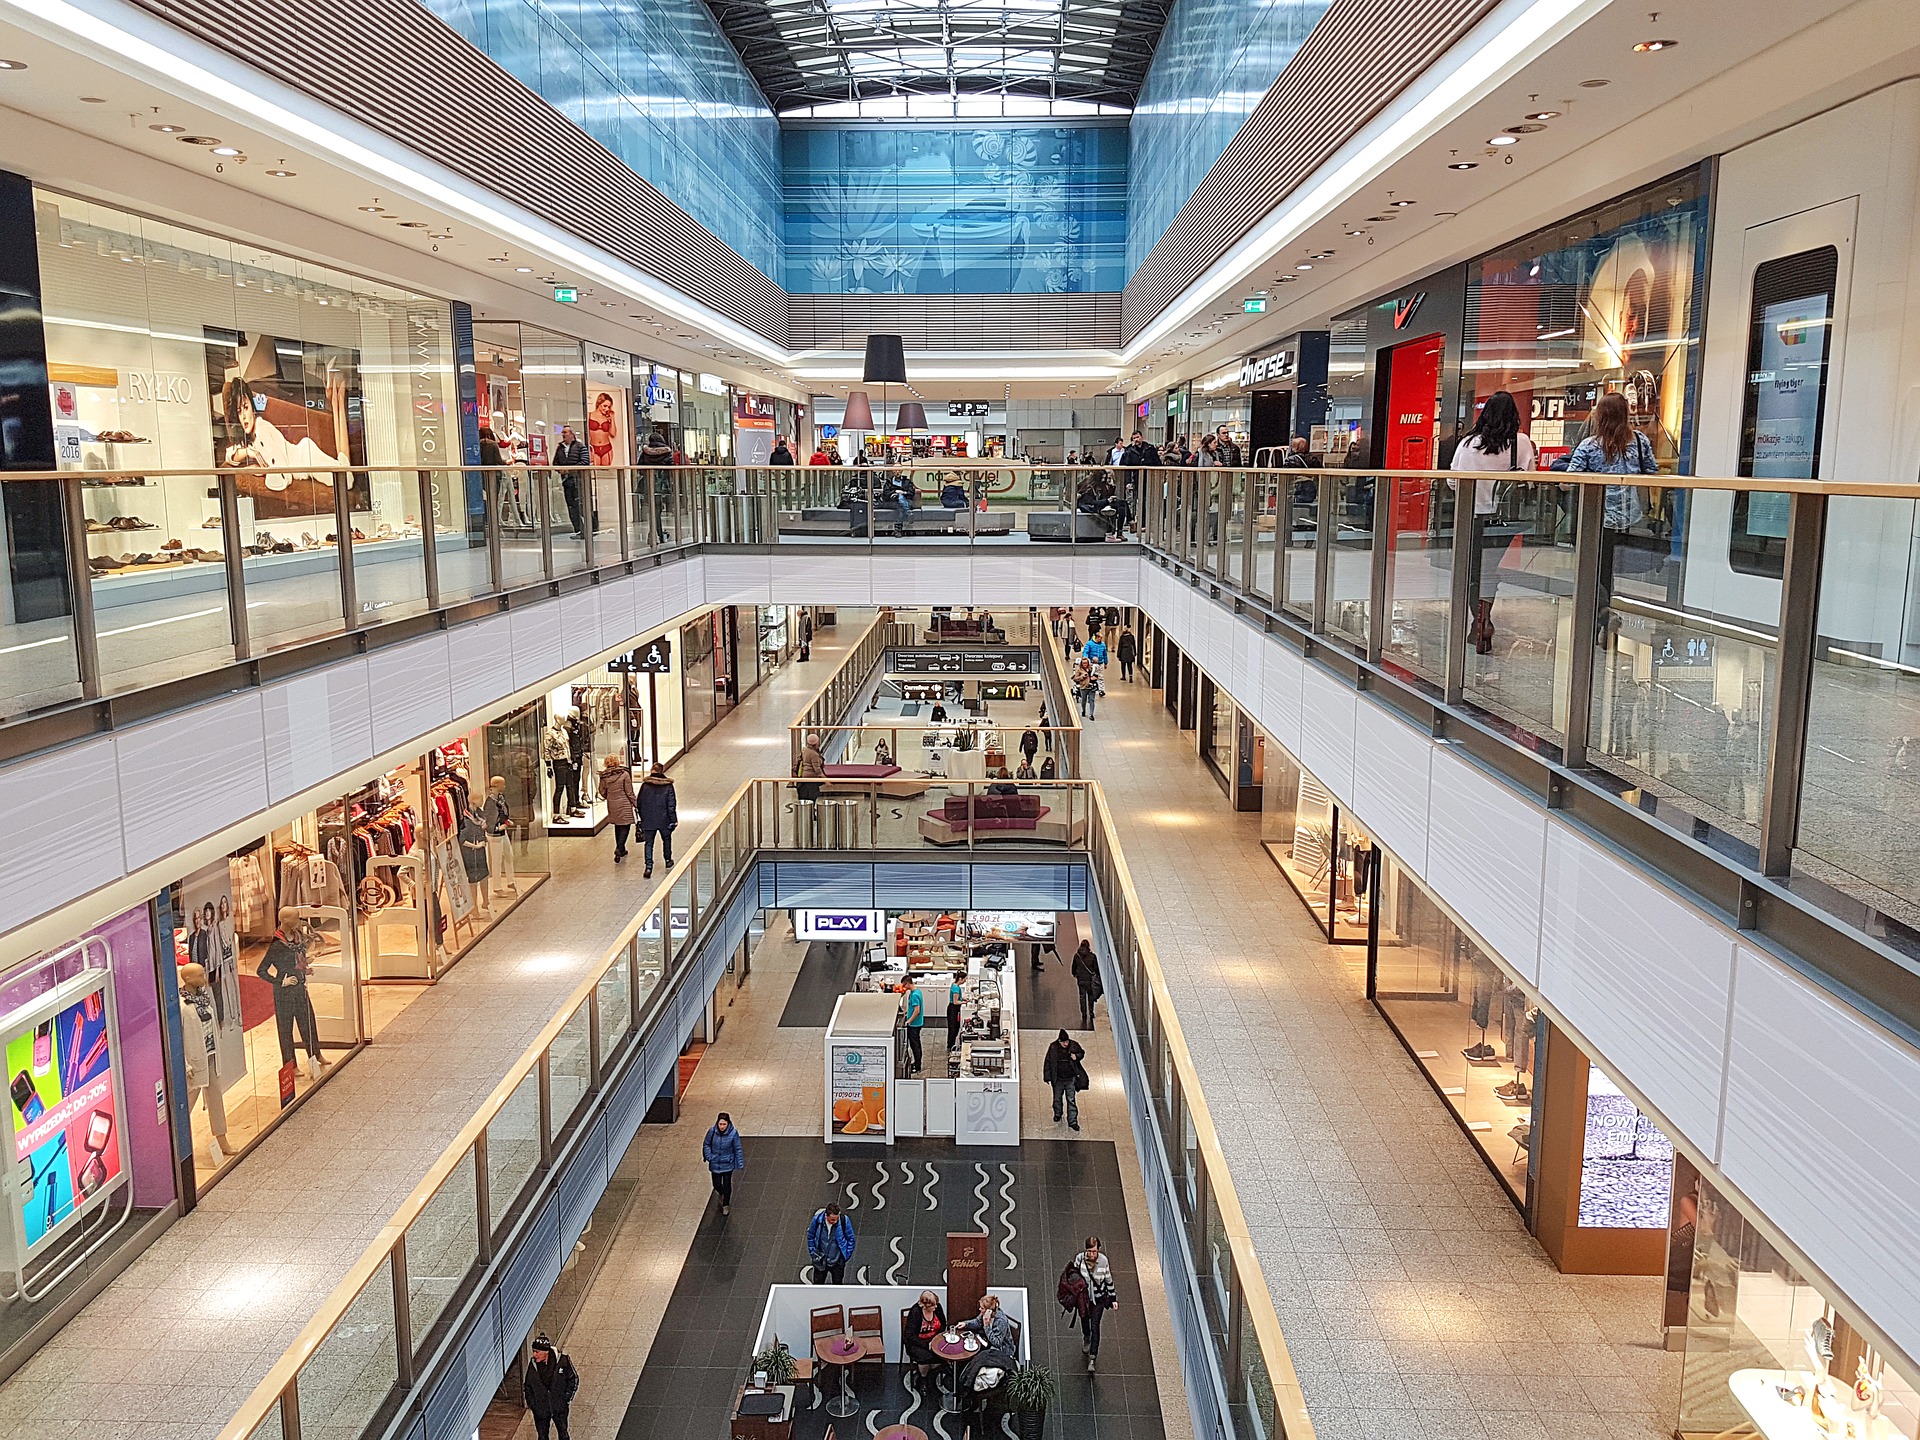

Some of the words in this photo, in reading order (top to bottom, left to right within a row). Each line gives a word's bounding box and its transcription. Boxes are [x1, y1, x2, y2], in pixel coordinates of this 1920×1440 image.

[1240, 350, 1285, 387] diverse
[128, 372, 192, 404] RYŁKO
[653, 386, 676, 403] KLEX
[965, 404, 973, 412] P
[1400, 413, 1423, 424] NIKE
[61, 445, 80, 459] 2016
[817, 917, 864, 929] PLAY
[972, 915, 990, 923] 5,90
[17, 1103, 74, 1151] WYPRZEDAŻ
[73, 1094, 87, 1112] DO
[1593, 1113, 1640, 1128] NOWY
[951, 1259, 983, 1268] Tchibo
